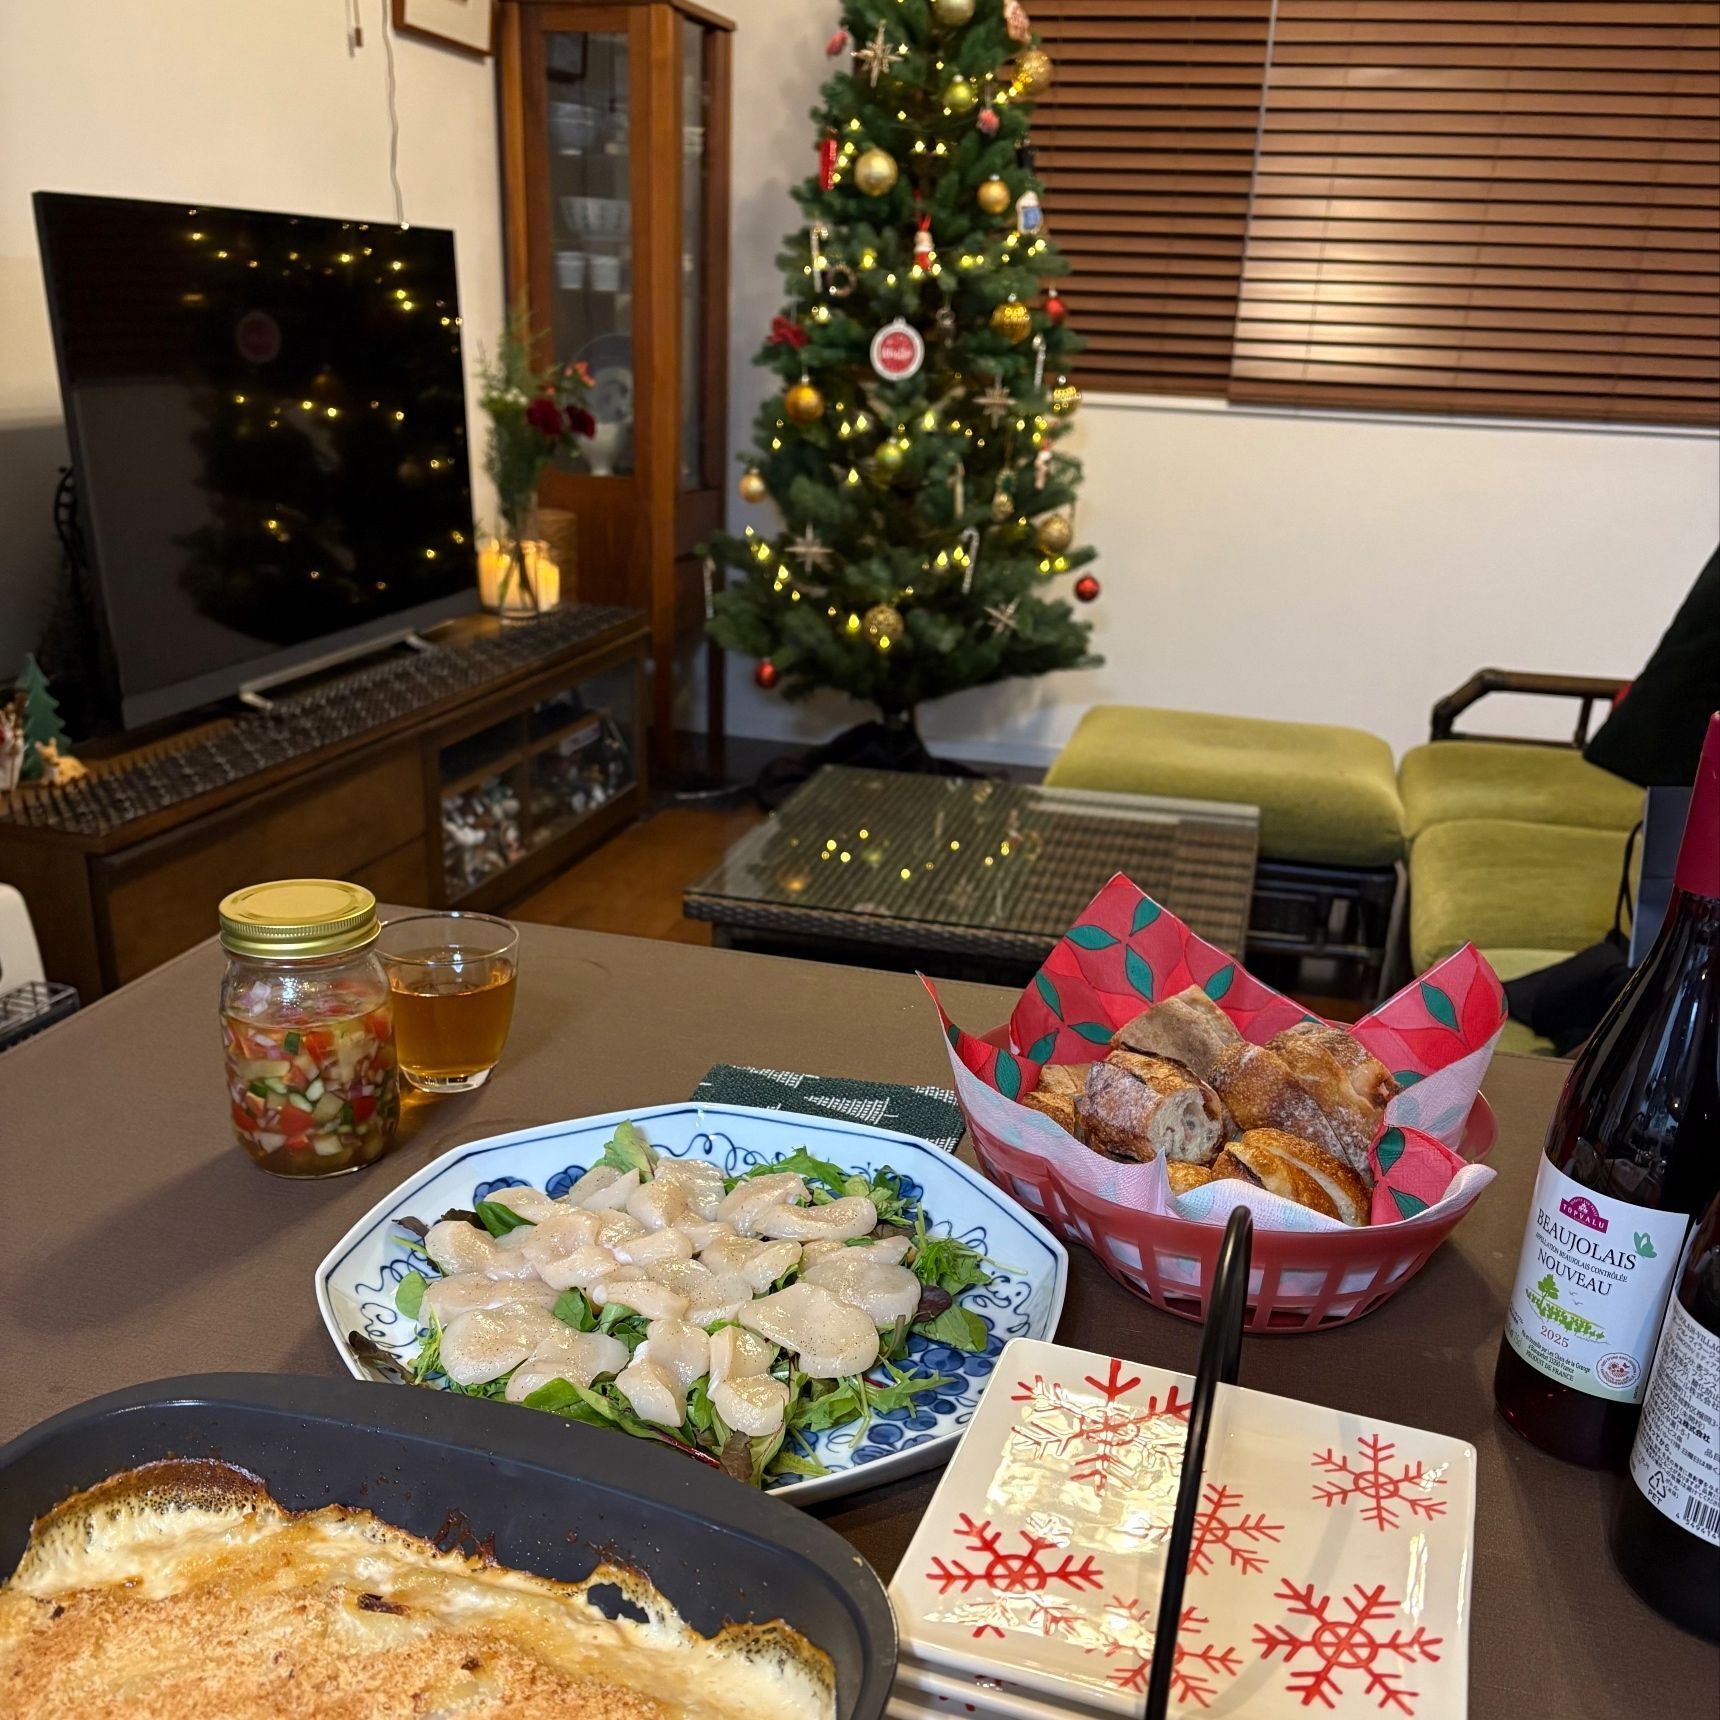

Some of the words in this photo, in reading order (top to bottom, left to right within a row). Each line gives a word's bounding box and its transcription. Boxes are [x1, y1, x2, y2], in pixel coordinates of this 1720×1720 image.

[1562, 1203, 1605, 1230] TOPVALU
[1537, 1208, 1637, 1270] BEAUJOLAIS
[1559, 1248, 1590, 1270] BEAUJOLAIS
[1537, 1248, 1612, 1296] NOUVEAU
[1540, 1325, 1569, 1348] 2025
[1553, 1367, 1574, 1381] FRANCE
[1648, 1488, 1662, 1505] PET
